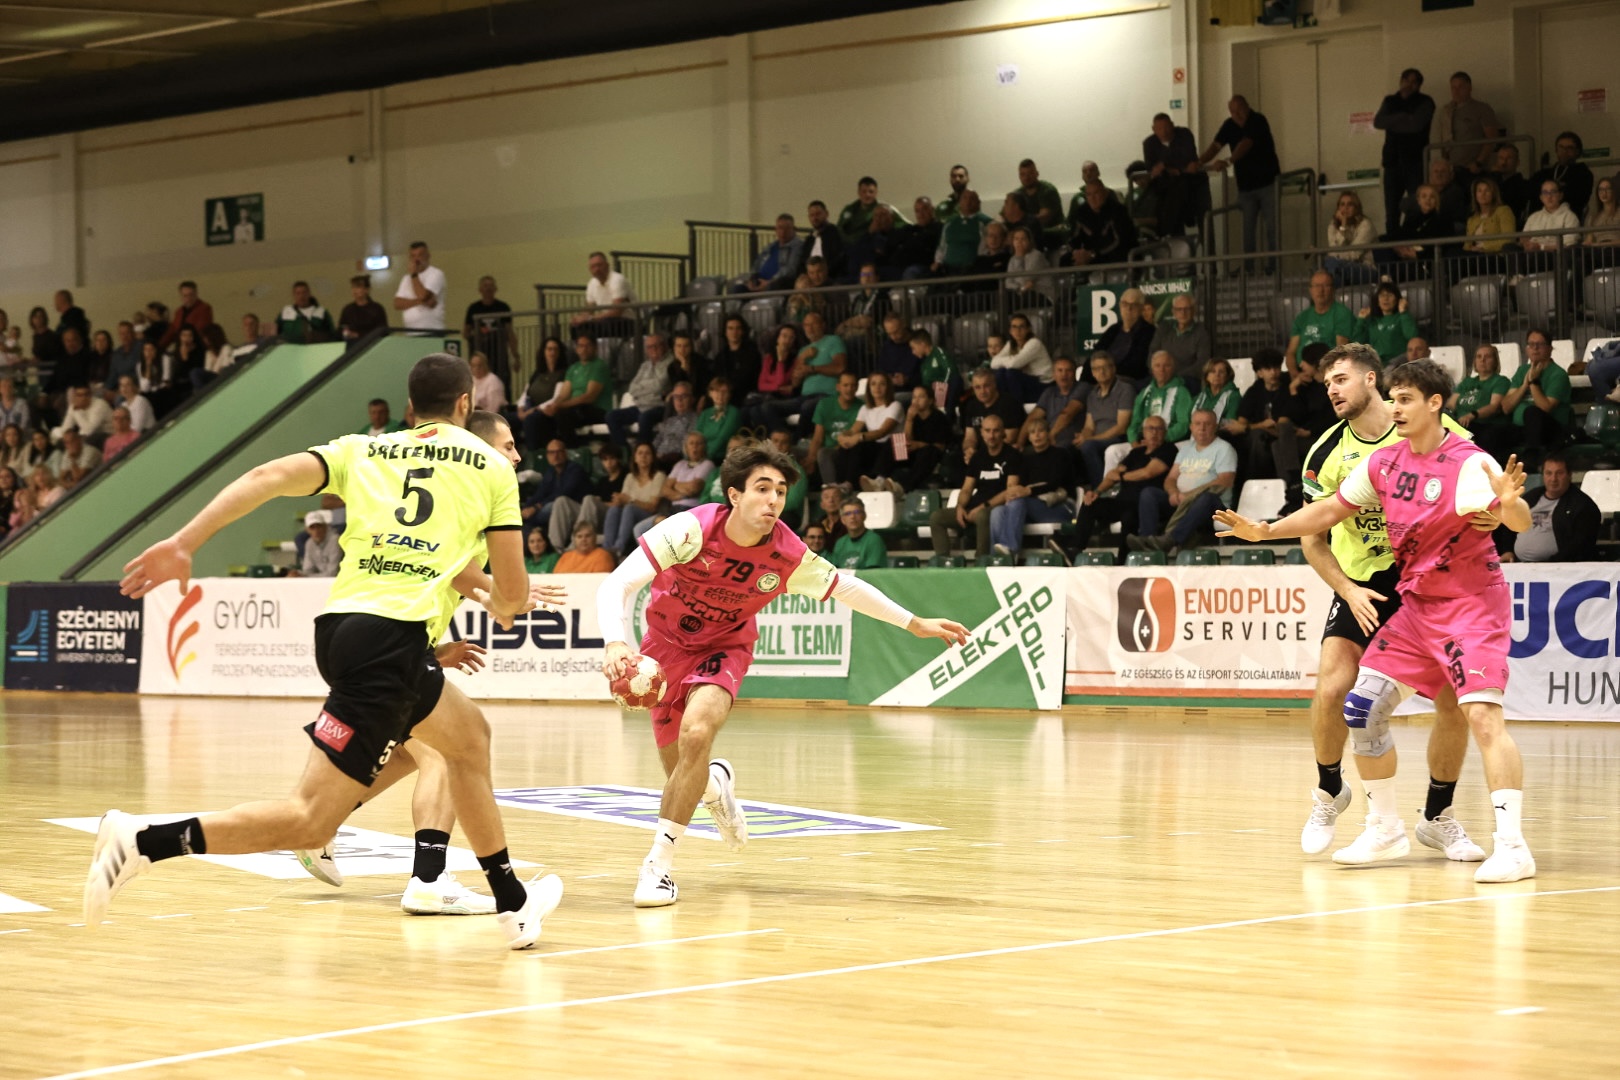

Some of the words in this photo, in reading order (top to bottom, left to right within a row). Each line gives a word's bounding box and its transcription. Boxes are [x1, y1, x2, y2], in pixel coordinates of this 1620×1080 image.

[999, 71, 1016, 83] VIP
[211, 202, 229, 232] A
[1091, 290, 1118, 334] B
[368, 441, 486, 470] SRETENOVIC
[394, 467, 434, 527] 5
[1391, 471, 1419, 501] 99
[386, 534, 440, 552] ZAEV
[721, 557, 754, 583] 79
[57, 605, 140, 629] SZÉCHENYI
[214, 593, 280, 629] GYŐRI
[1329, 601, 1341, 620] 8
[56, 631, 126, 650] EGYETEM
[791, 625, 843, 655] TEAM
[929, 586, 1053, 691] ELEKTRO
[1183, 621, 1307, 641] SERVICE
[492, 655, 537, 673] Életünk
[540, 661, 548, 673] a
[550, 657, 604, 677] logisztika
[1121, 669, 1132, 679] AZ
[1134, 667, 1173, 679] EGÉSZSÉG
[1175, 667, 1185, 679] ÉS
[1187, 669, 1197, 679] AZ
[1199, 667, 1231, 680] ÉLSPORT
[1233, 668, 1301, 680] SZOLGÁLATÁBAN
[1548, 671, 1620, 704] HUN
[323, 720, 349, 740] BÁV
[379, 739, 397, 764] 5
